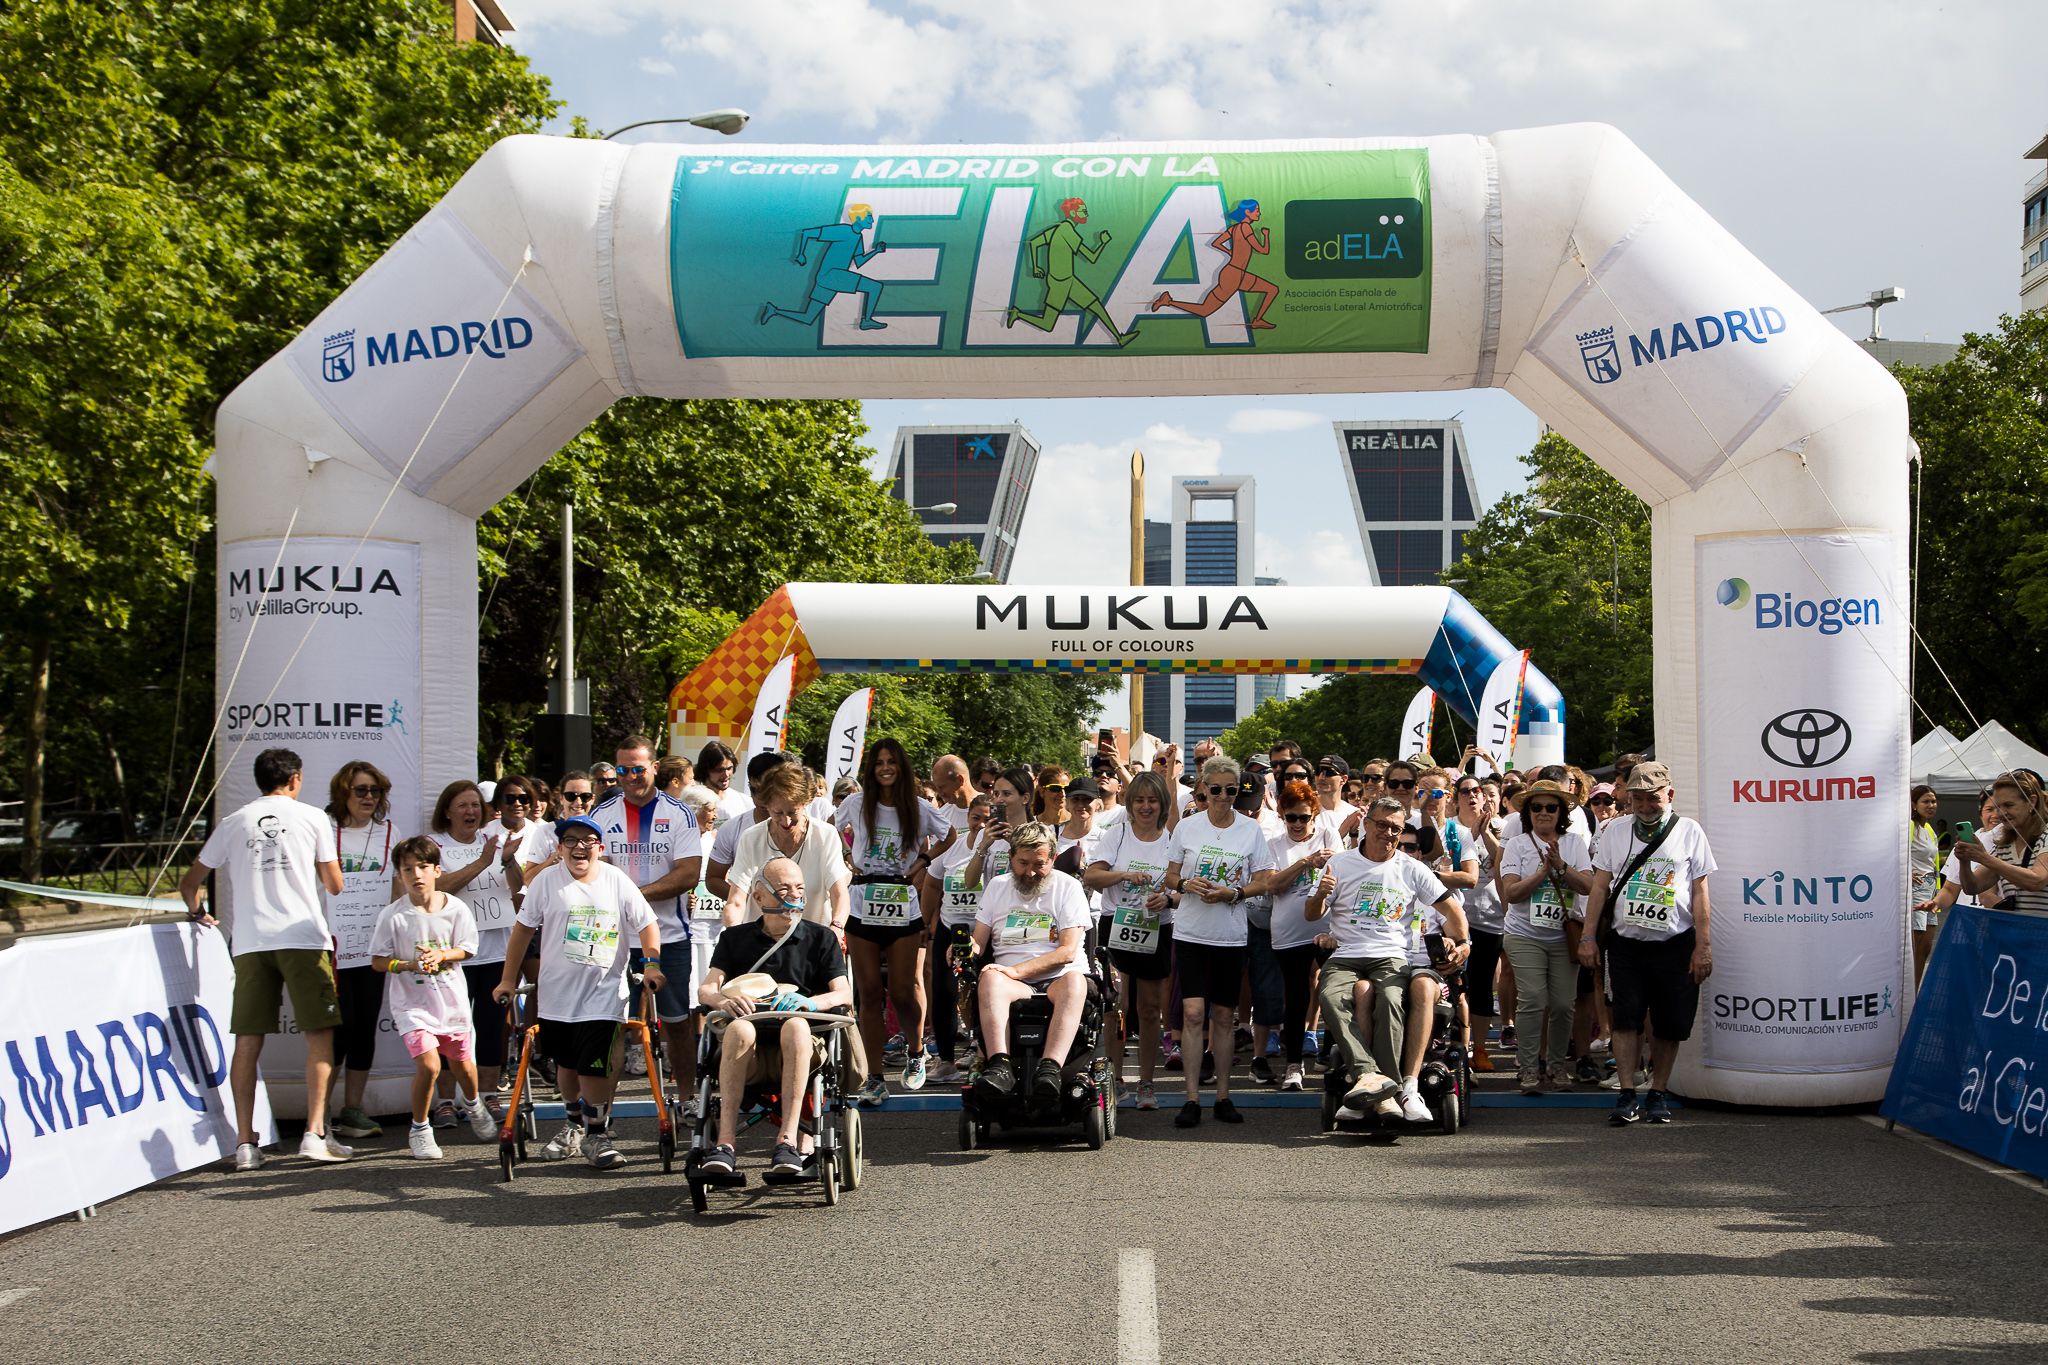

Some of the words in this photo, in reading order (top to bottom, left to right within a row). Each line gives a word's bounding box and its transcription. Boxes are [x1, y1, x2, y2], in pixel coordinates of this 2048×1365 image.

[729, 159, 840, 175] Carrera
[851, 158, 1040, 180] MADRID
[1052, 157, 1152, 179] CON
[1162, 156, 1220, 178] LA
[1304, 232, 1404, 261] adELA
[817, 182, 1256, 351] ELA
[1284, 288, 1337, 298] Asociación
[1339, 287, 1382, 299] Española
[1384, 287, 1397, 297] de
[1284, 303, 1332, 312] Esclerosis
[1334, 302, 1366, 312] Lateral
[1368, 301, 1423, 311] Amiotrófica
[366, 316, 534, 367] MADRID
[1628, 306, 1788, 367] MADRID
[1352, 431, 1438, 450] REALIA
[229, 565, 402, 597] MUKUA
[229, 604, 244, 623] by
[976, 595, 1269, 631] MUKUA
[1755, 592, 1880, 636] Biogen
[1051, 640, 1088, 652] FULL
[1092, 640, 1114, 652] OF
[1118, 640, 1195, 652] COLOURS
[227, 702, 384, 730] SPORTLIFE
[228, 733, 262, 742] MOVIDAD,
[263, 730, 330, 741] COMUNICACIÓN
[332, 732, 338, 740] Y
[340, 732, 383, 741] EVENTOS
[655, 824, 669, 832] OL
[610, 840, 670, 854] Emirates
[951, 893, 977, 906] 342
[1635, 887, 1665, 903] ELA
[473, 896, 502, 922] NO
[868, 902, 904, 918] 1791
[1628, 901, 1668, 921] 1466
[1743, 913, 1784, 922] Flexible
[1786, 912, 1829, 925] Mobility
[1831, 910, 1874, 921] Solutions
[1119, 927, 1151, 945] 857
[588, 944, 594, 956] 1
[1981, 953, 2031, 1025] De
[1714, 992, 1879, 1022] SPORTLIFE
[1715, 1021, 1764, 1035] MOVILIDAD,
[1765, 1024, 1835, 1035] COMUNICACIÓN
[1836, 1025, 1843, 1033] Y
[1843, 1021, 1878, 1033] EVENTOS
[5, 1002, 228, 1137] MADRID
[1959, 1050, 1993, 1114] al
